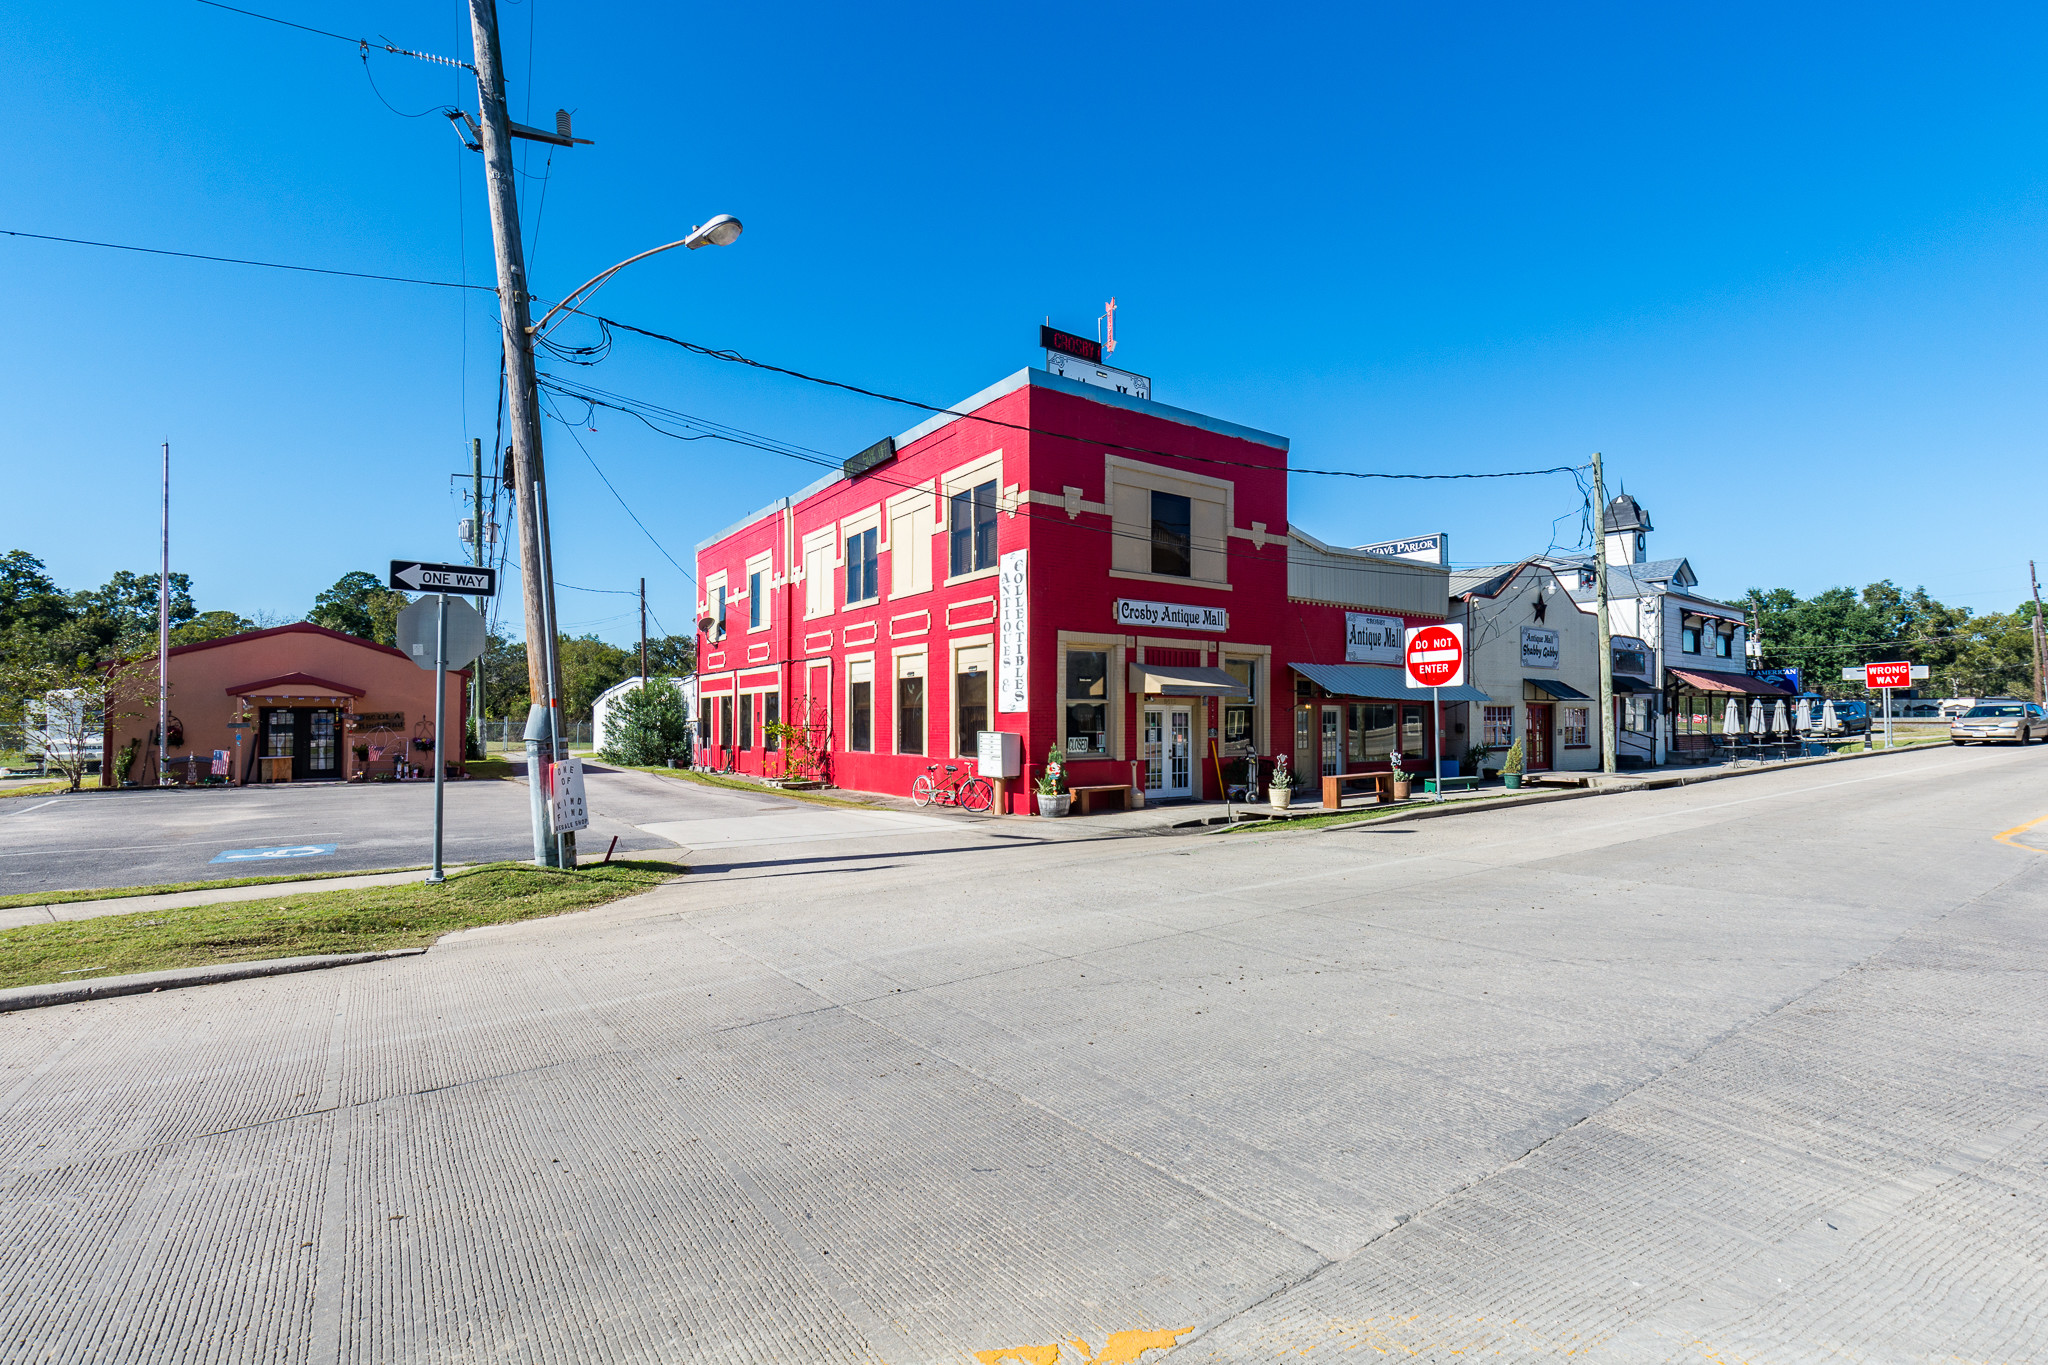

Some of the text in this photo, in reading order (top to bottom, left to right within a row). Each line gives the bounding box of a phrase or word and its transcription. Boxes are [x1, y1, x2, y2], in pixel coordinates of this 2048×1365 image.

[1054, 332, 1094, 358] CROSBY
[1396, 540, 1436, 553] PARLOR
[422, 571, 485, 587] ONE WAY
[1001, 572, 1012, 669] ANTIQUES
[1121, 602, 1224, 627] Crosby Antique Mall
[1014, 559, 1025, 702] COLLECTIBLES
[1348, 623, 1402, 650] Antique Mall
[1415, 637, 1453, 649] DO NOT
[1526, 633, 1553, 644] Antique Mall
[1523, 643, 1542, 658] Shabby
[1419, 663, 1449, 674] ENTER
[1868, 665, 1908, 675] WRONG
[1876, 675, 1900, 685] WAY
[1068, 738, 1087, 751] CLOSED
[557, 766, 574, 775] ONE
[561, 777, 571, 785] OF
[557, 797, 582, 810] KIND
[557, 808, 583, 822] FIND
[555, 818, 588, 831] RESALE SHOP
